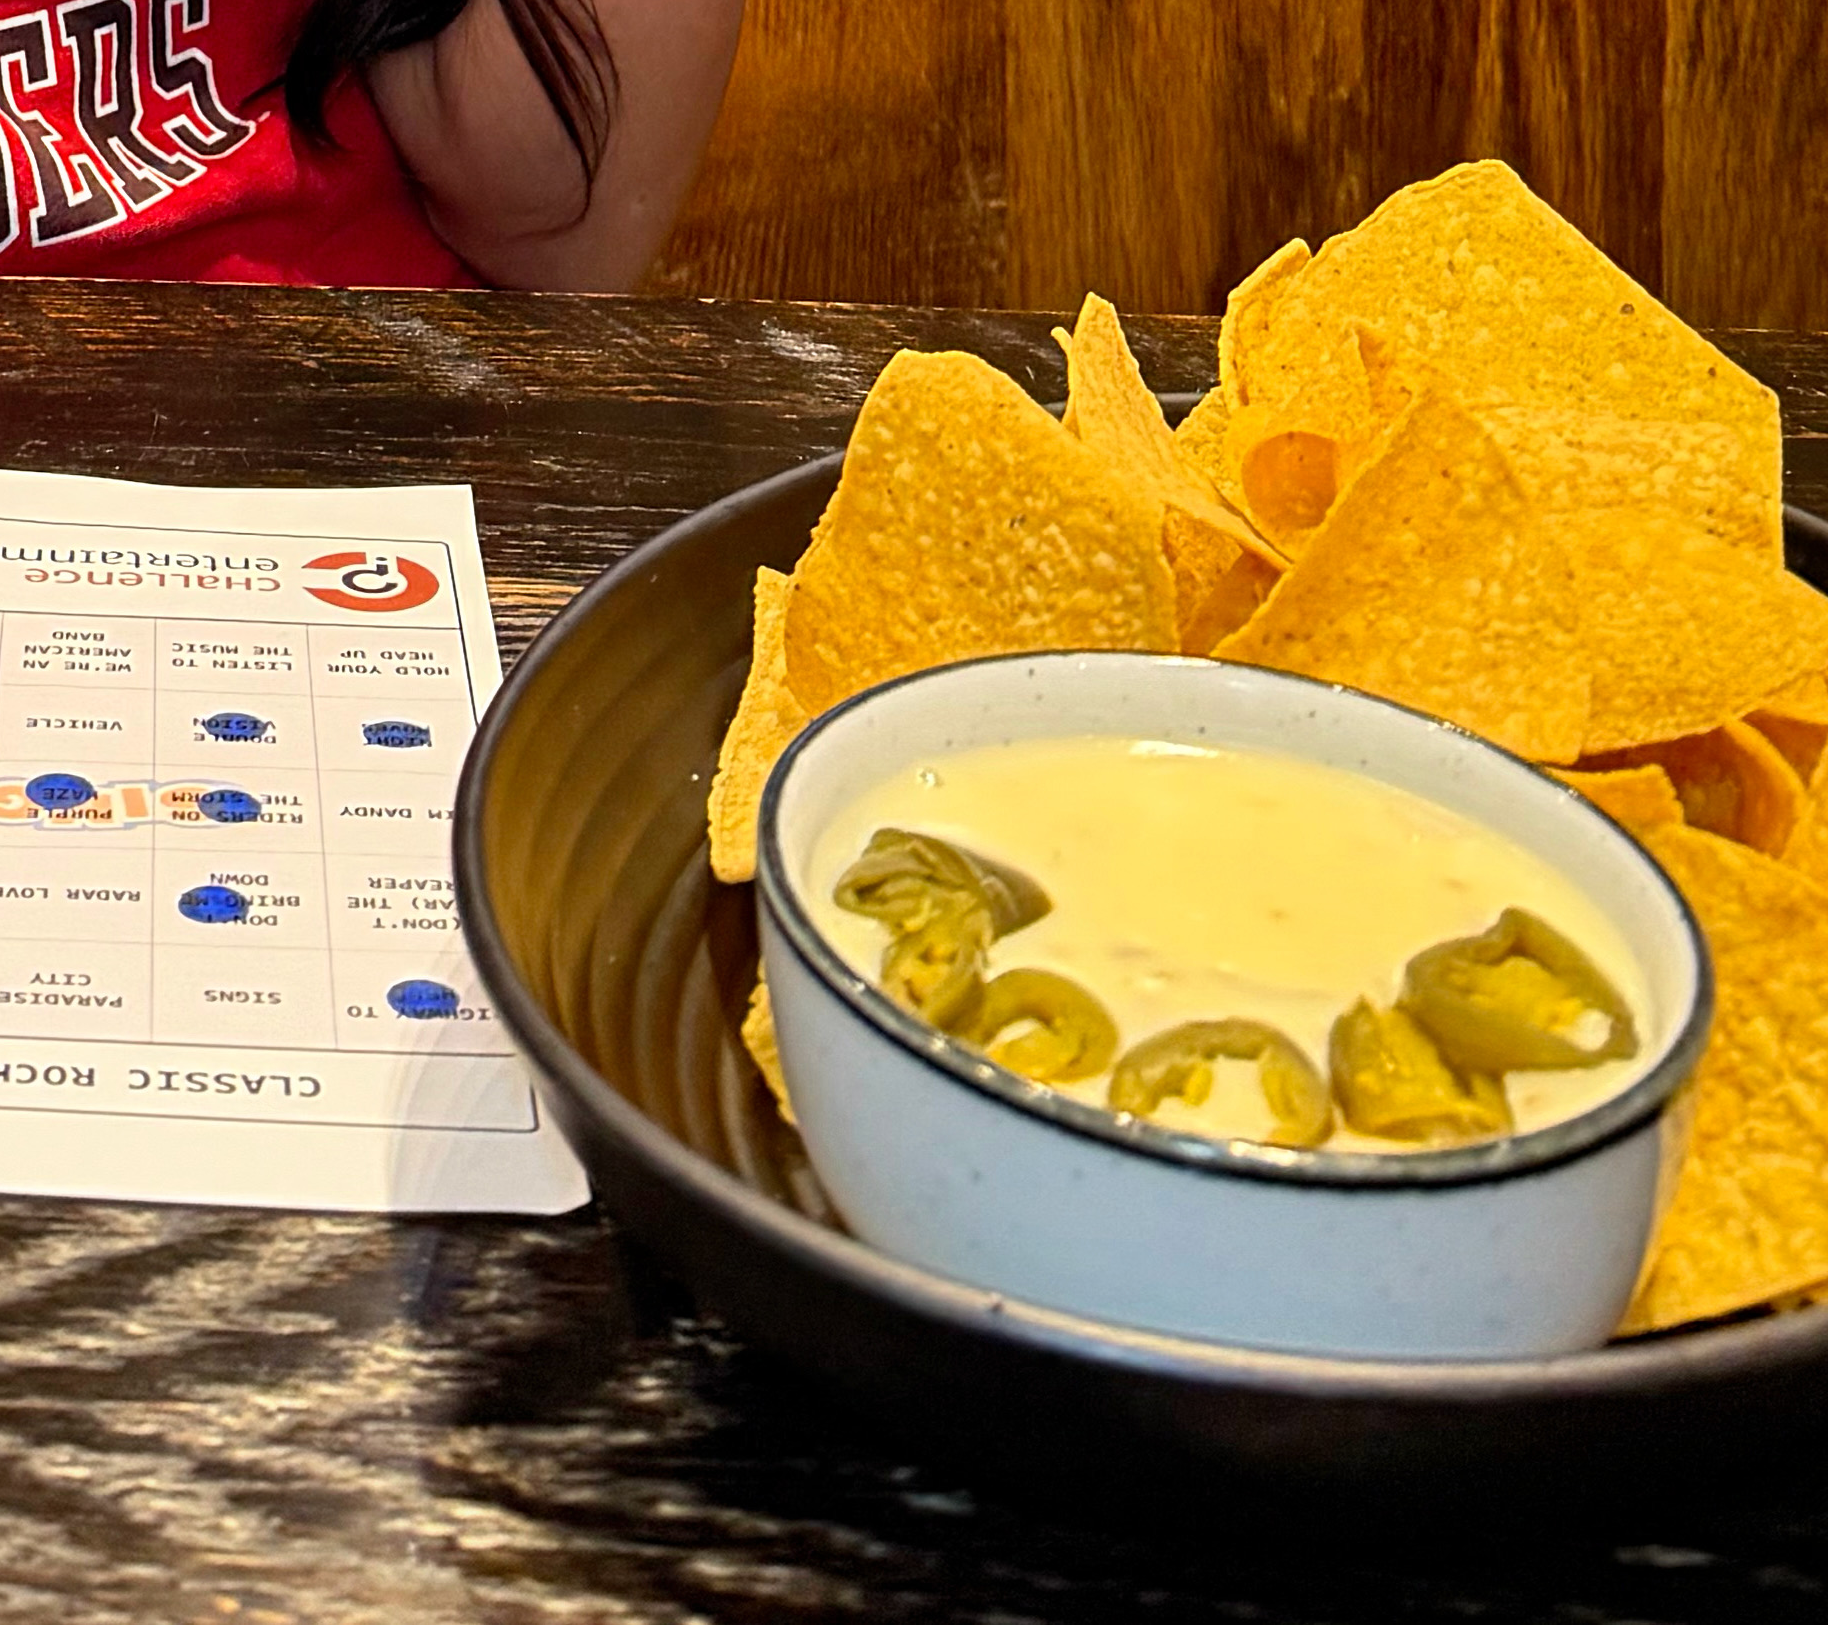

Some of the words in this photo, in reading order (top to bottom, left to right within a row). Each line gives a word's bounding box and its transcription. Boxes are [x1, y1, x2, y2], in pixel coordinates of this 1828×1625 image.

[51, 630, 105, 642] BAND
[23, 644, 132, 657] AMERICAN
[171, 642, 239, 654] MUSIC
[253, 645, 293, 656] THE
[339, 649, 366, 659] UP
[380, 650, 434, 660] HEAD
[22, 659, 50, 670] AN
[64, 660, 131, 672] WE'RE
[171, 657, 199, 668] TO
[212, 659, 292, 671] LISTEN
[327, 663, 382, 675] YOUR
[395, 665, 450, 676] HOLD
[25, 717, 123, 731] VEHICLE
[193, 717, 276, 731] VISION
[193, 732, 277, 744] DOUBLE
[42, 787, 98, 801] HAZE
[259, 794, 302, 806] THE
[26, 807, 112, 820] PURPLE
[171, 810, 200, 821] ON
[339, 805, 412, 819] DANDY
[210, 873, 269, 887] DOWN
[66, 888, 141, 902] RADAR
[347, 896, 391, 910] THE
[30, 972, 92, 986] CITY
[204, 989, 282, 1005] SIGNS
[347, 1006, 379, 1019] TO
[128, 1069, 321, 1098] CLASSIC
